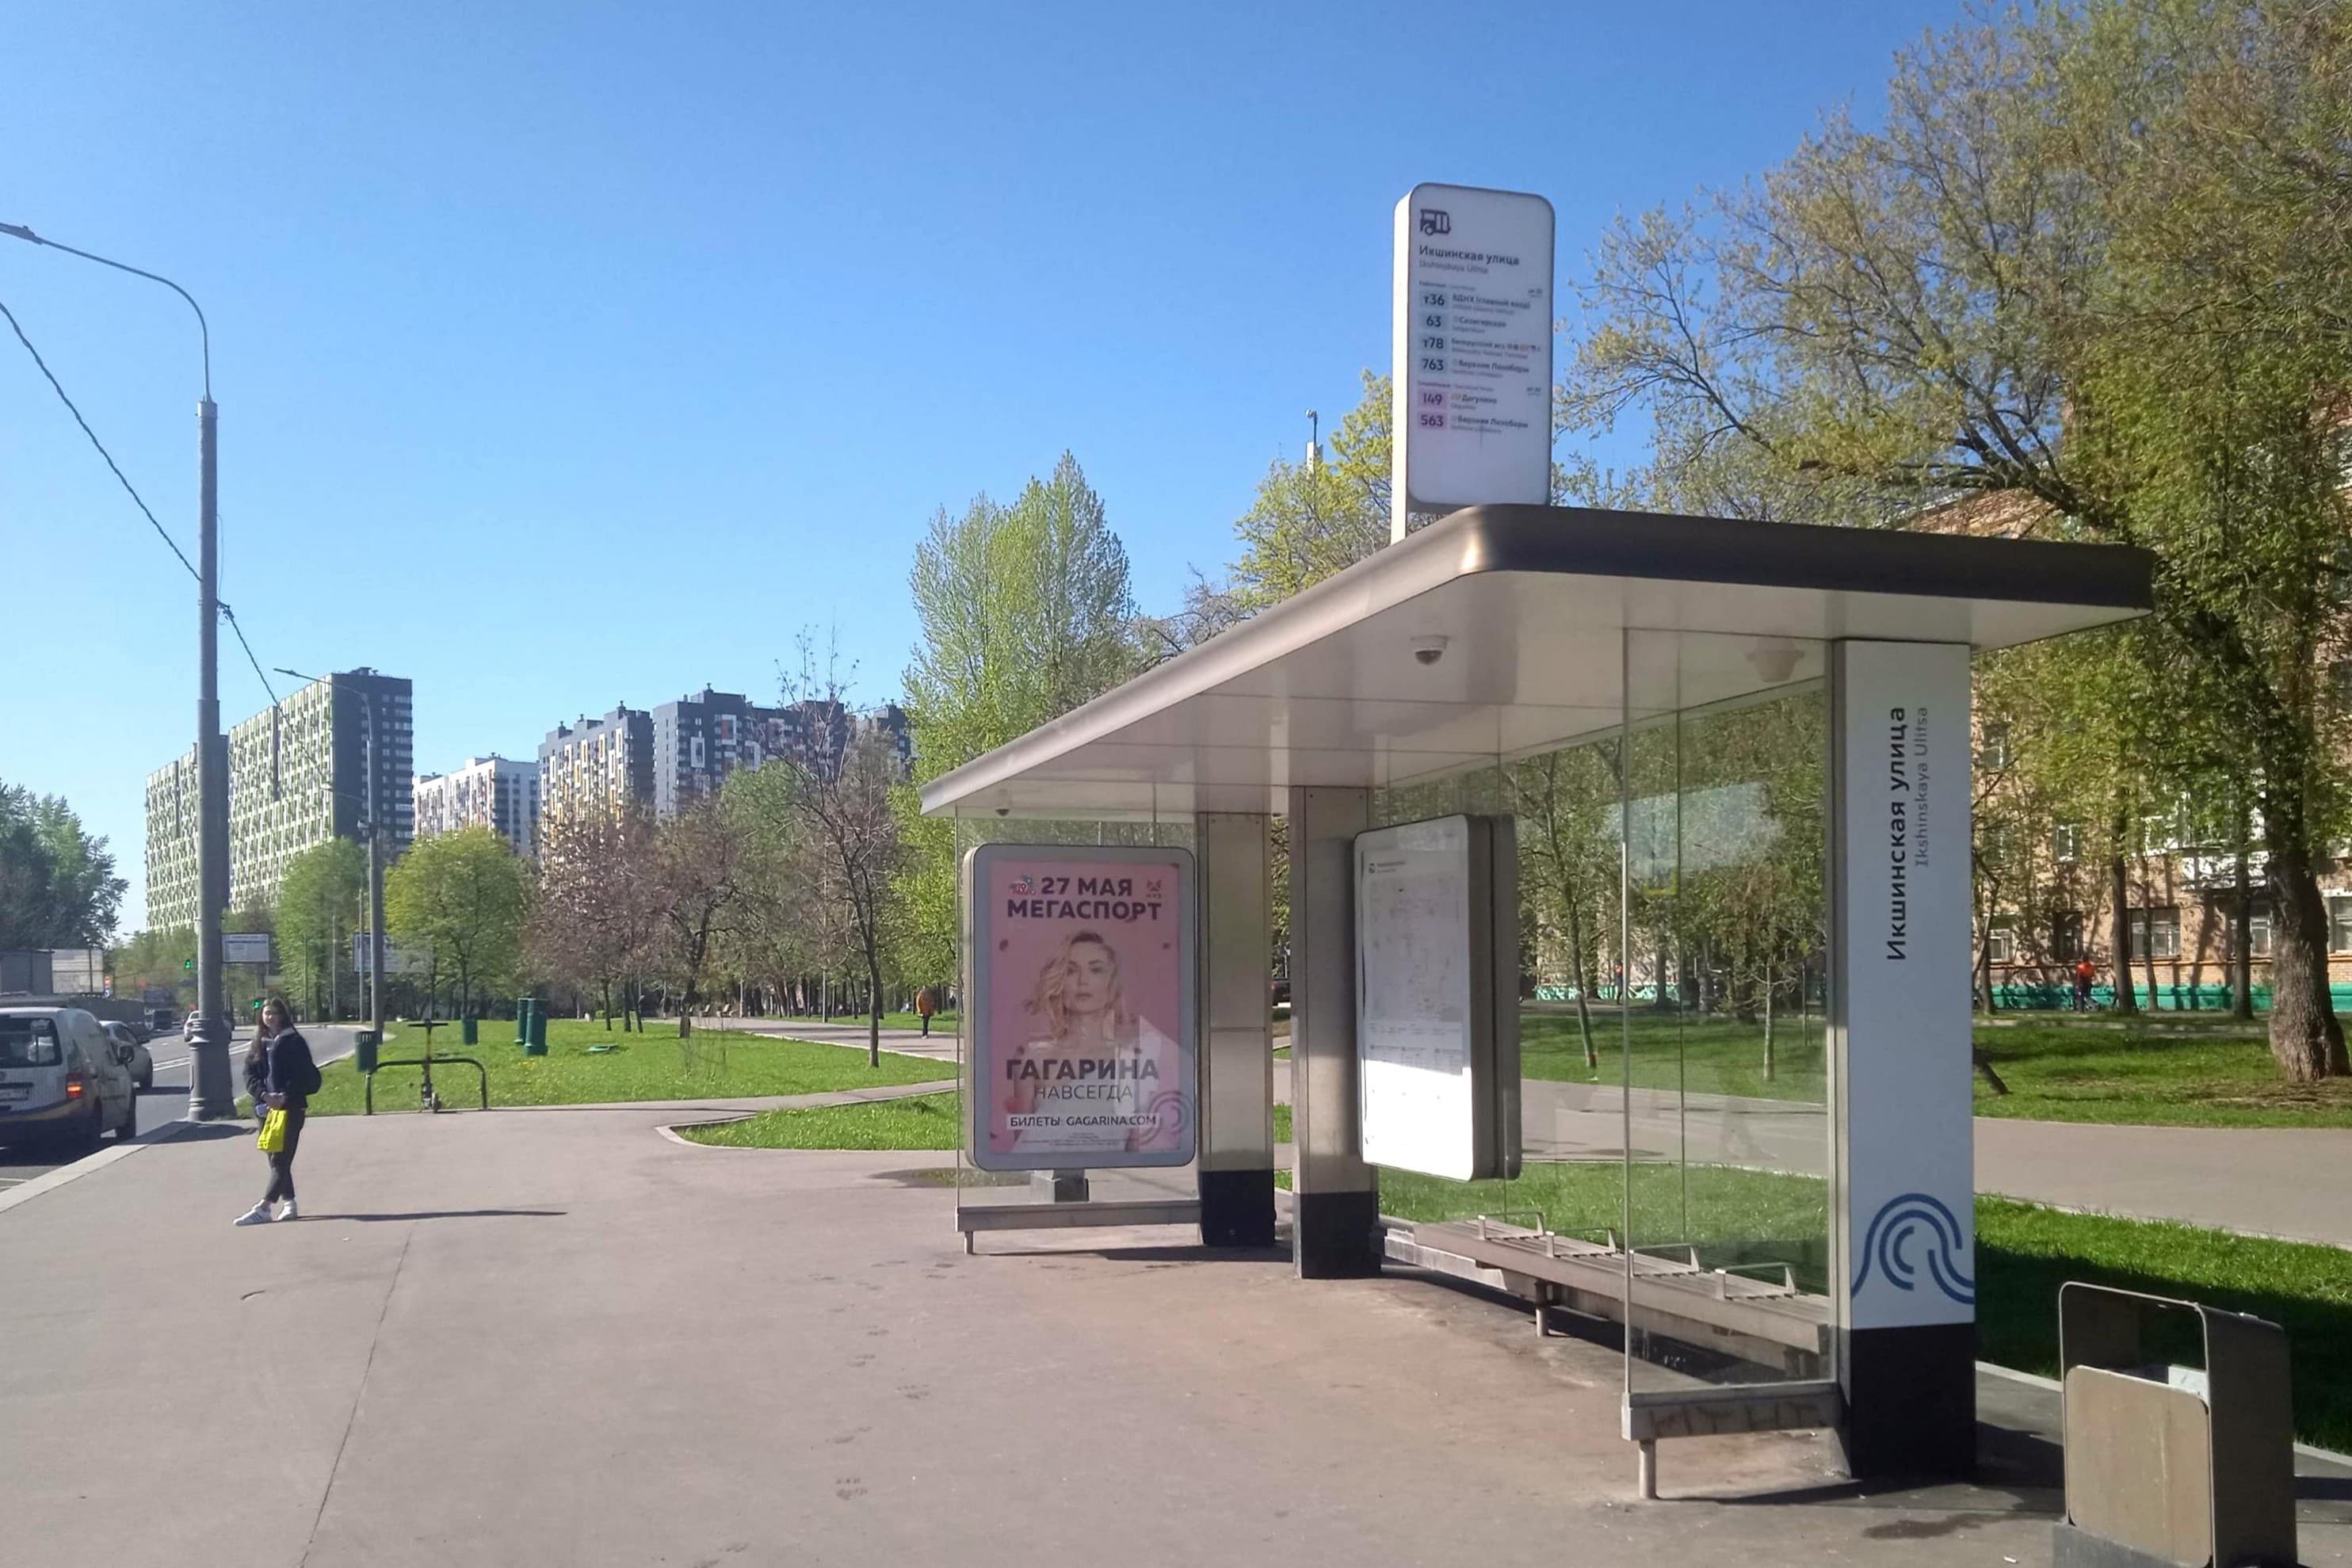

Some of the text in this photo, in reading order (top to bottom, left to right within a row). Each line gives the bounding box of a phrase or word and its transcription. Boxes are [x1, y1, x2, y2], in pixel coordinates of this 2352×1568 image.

[1419, 245, 1520, 266] Икшинская улица
[1426, 315, 1441, 327] 63
[1422, 359, 1444, 371] 763
[1423, 393, 1442, 405] 149
[1420, 414, 1444, 427] 563
[1915, 707, 1931, 868] Ikshinskaya Ulitsa
[1887, 707, 1910, 960] Икшинская улица
[1040, 876, 1070, 895] 27
[1078, 877, 1132, 897] МАЯ
[1007, 898, 1162, 921] МЕГАСПОРТ
[1006, 1059, 1159, 1081] ГАГАРИНА
[1033, 1085, 1134, 1103] НАВСЕГДА
[1066, 1116, 1157, 1127] GAGARINA.COM
